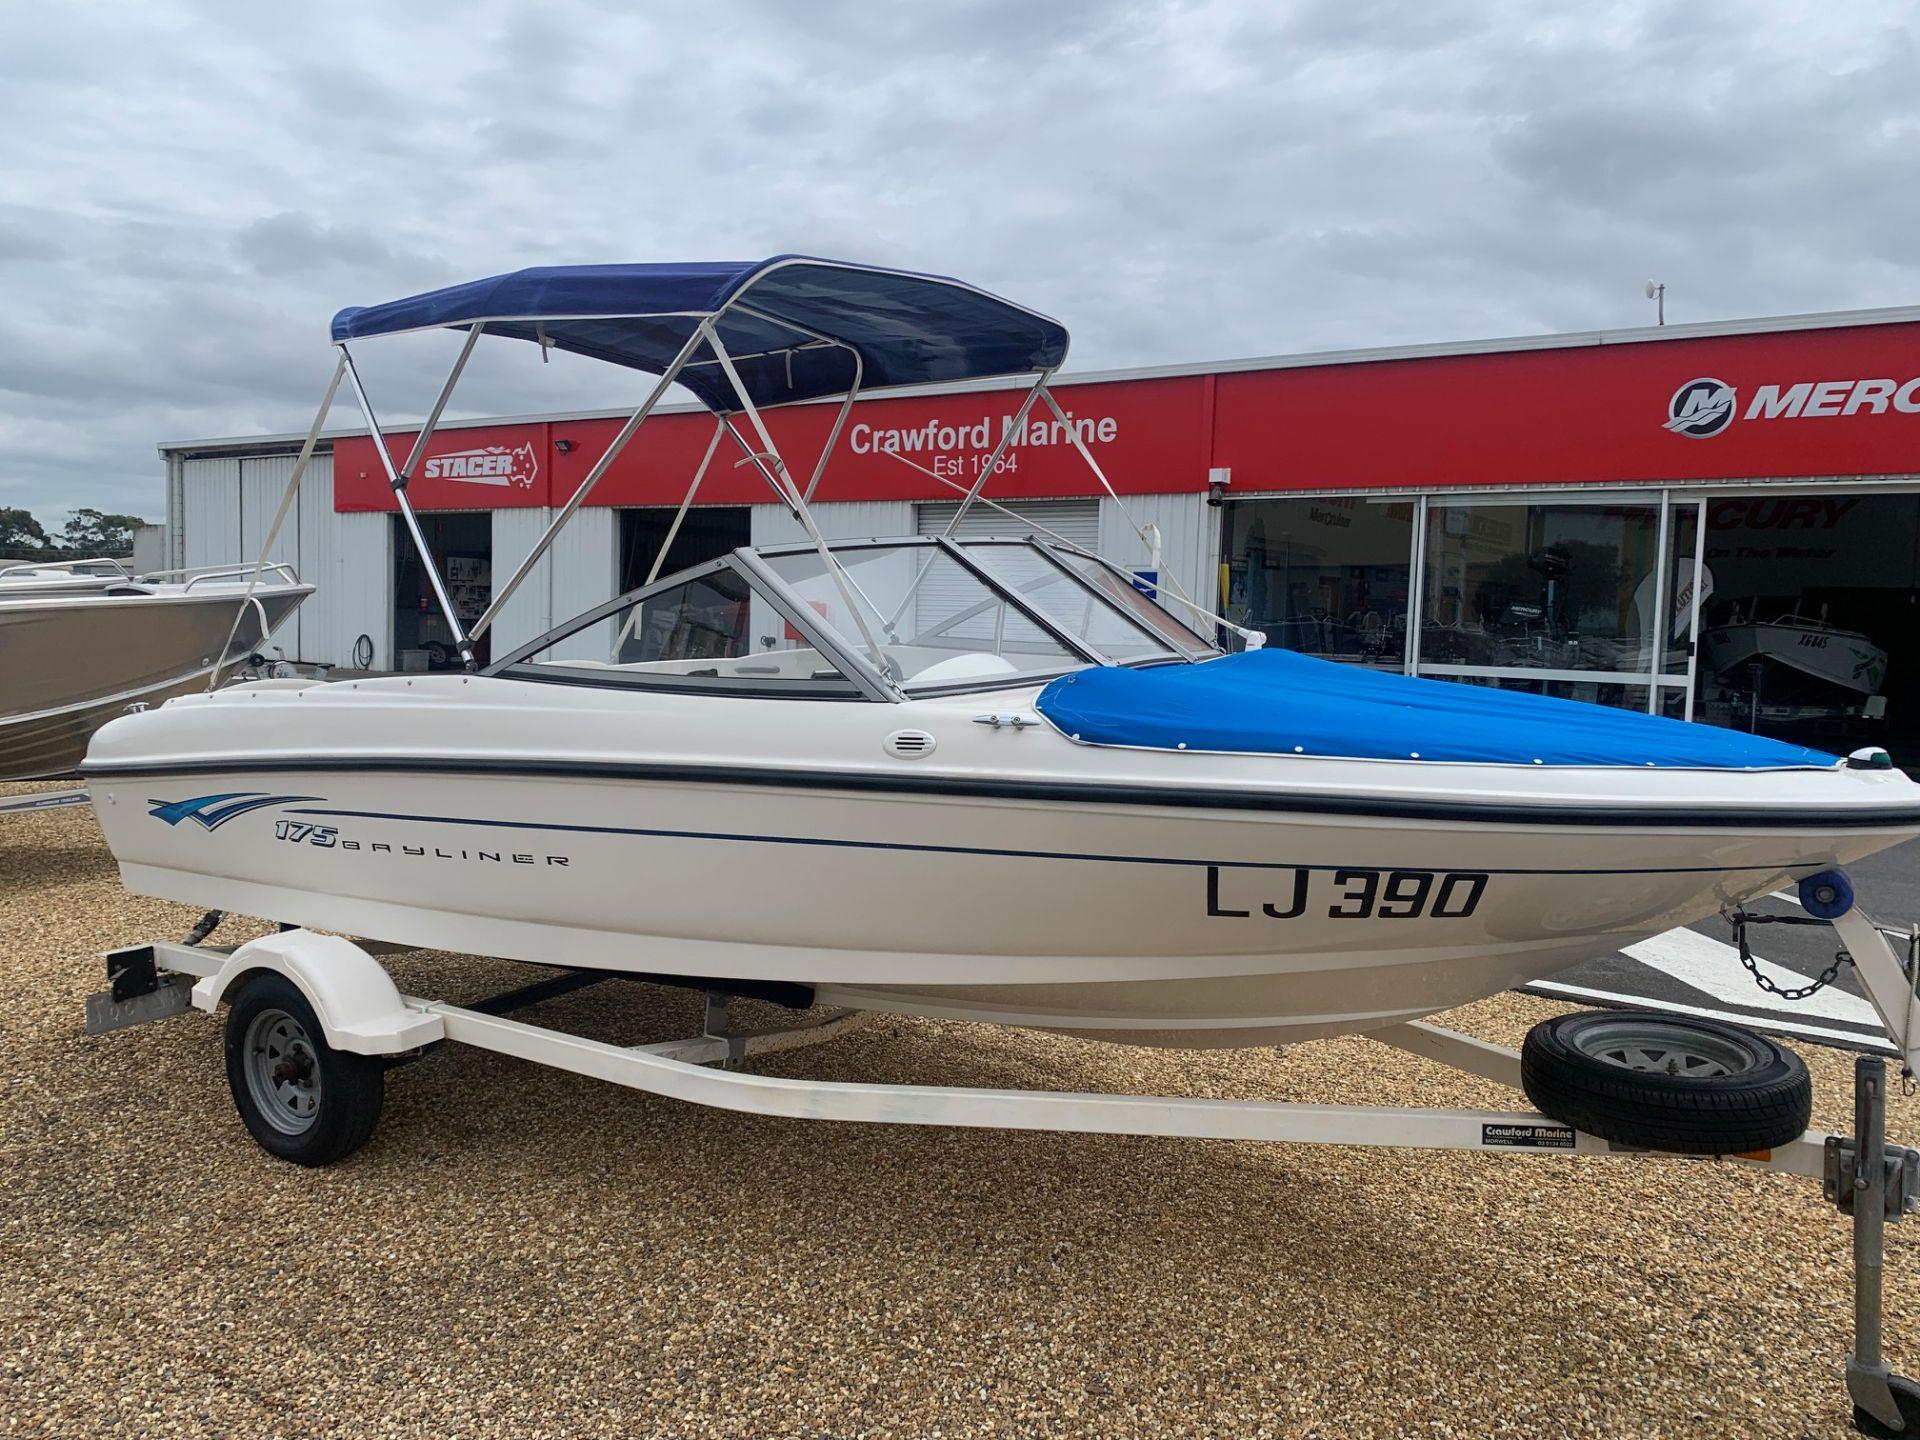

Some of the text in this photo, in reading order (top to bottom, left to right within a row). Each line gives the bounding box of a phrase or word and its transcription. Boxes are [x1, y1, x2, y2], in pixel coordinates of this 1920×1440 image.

[851, 412, 1118, 454] Crawford Marine
[424, 454, 514, 479] STACER
[934, 453, 1018, 476] Est 1964
[1736, 548, 1769, 558] The
[1776, 547, 1837, 559] Water
[1510, 604, 1543, 615] MERCURY
[275, 820, 570, 867] 175 BAYLINER
[1328, 870, 1489, 919] 390
[1486, 1126, 1532, 1136] Crawford
[1535, 1128, 1573, 1139] Marine
